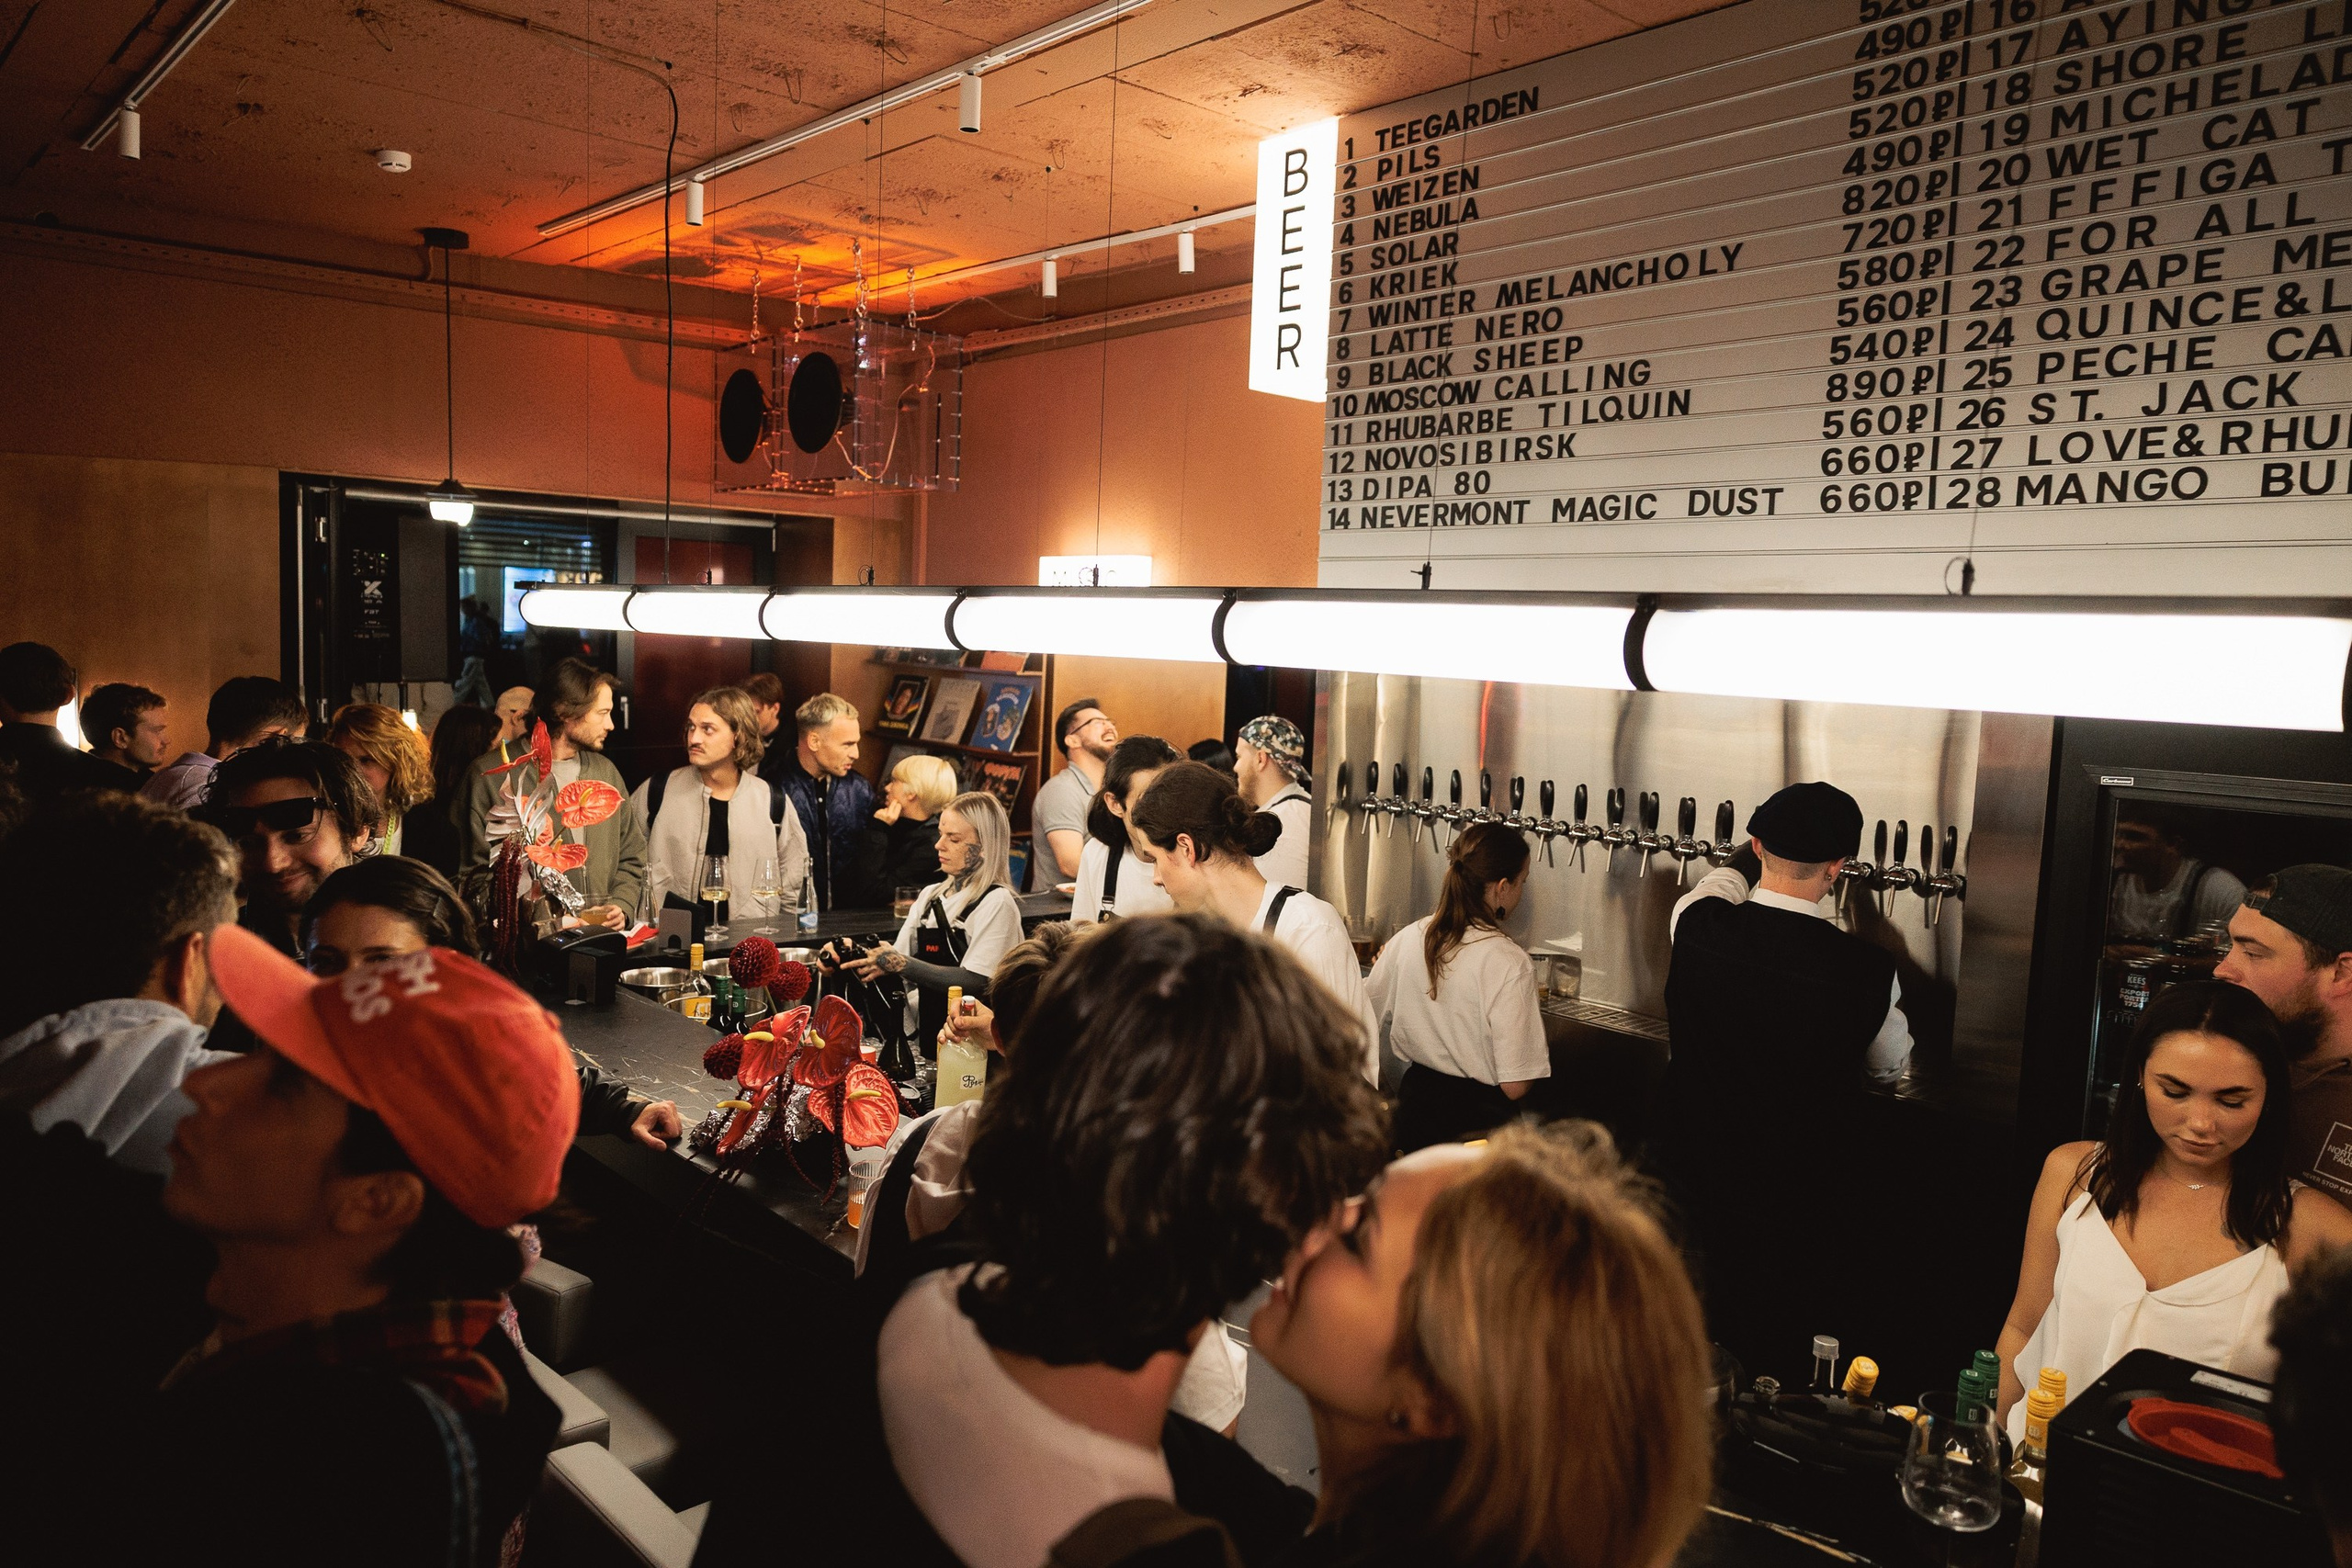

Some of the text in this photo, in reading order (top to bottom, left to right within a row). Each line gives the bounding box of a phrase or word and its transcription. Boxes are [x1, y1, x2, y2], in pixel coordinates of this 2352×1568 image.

[1986, 29, 2034, 70] 17
[1989, 0, 2036, 29] 16
[1983, 6, 2352, 111] 18 SHORE L
[1341, 50, 1959, 219] 3 WEIZEN 520₽
[1342, 8, 1962, 190] 2 PILS 490₽
[1345, 137, 1353, 160] 1
[1375, 85, 1539, 152] TEEGARDEN
[1980, 112, 2030, 152] 19
[1340, 90, 1955, 246] 4 NEBULA 520₽
[1976, 97, 2321, 193] 20 WET CAT
[1340, 130, 1951, 276] 5 SOLAR 490₽
[1977, 194, 2022, 232] 21
[2048, 152, 2278, 220] FFFIGA
[1275, 147, 1309, 370] BEER
[1338, 169, 1949, 305] 6 KRIEK 820₽
[1972, 191, 2316, 273] 22 FOR ALL
[1336, 248, 1943, 361] 8 LATTE NERO 580₽
[1339, 208, 1945, 333] 7 WINTER MELANCHOLY 720₽
[1969, 275, 2023, 312] 23
[2041, 247, 2225, 302] GRAPE
[1332, 326, 1935, 418] 10 MOSCOW CALLING 540₽
[1336, 288, 1939, 389] 9 BLACK SHEEP 560₽
[1962, 321, 2352, 391] 25 PECHE CA
[1963, 316, 2015, 353] 24
[1329, 403, 1928, 474] 12 NOVOSIBIRSK 560₽
[1331, 365, 1935, 446] 11 RHUBARBE TILQUIN 890₽
[1956, 371, 2301, 431] 26 ST. JACK
[1329, 442, 1925, 502] 13 DIPA 80 660₽
[1946, 476, 2001, 510] 28
[2015, 466, 2209, 507] MANGO
[1951, 436, 2003, 470] 27
[1329, 480, 1923, 530] 14 NEVERMONT MAGIC DUST 660₽
[2127, 976, 2146, 985] KEES
[2321, 1179, 2339, 1189] STOP
[2327, 1144, 2352, 1160] NORT
